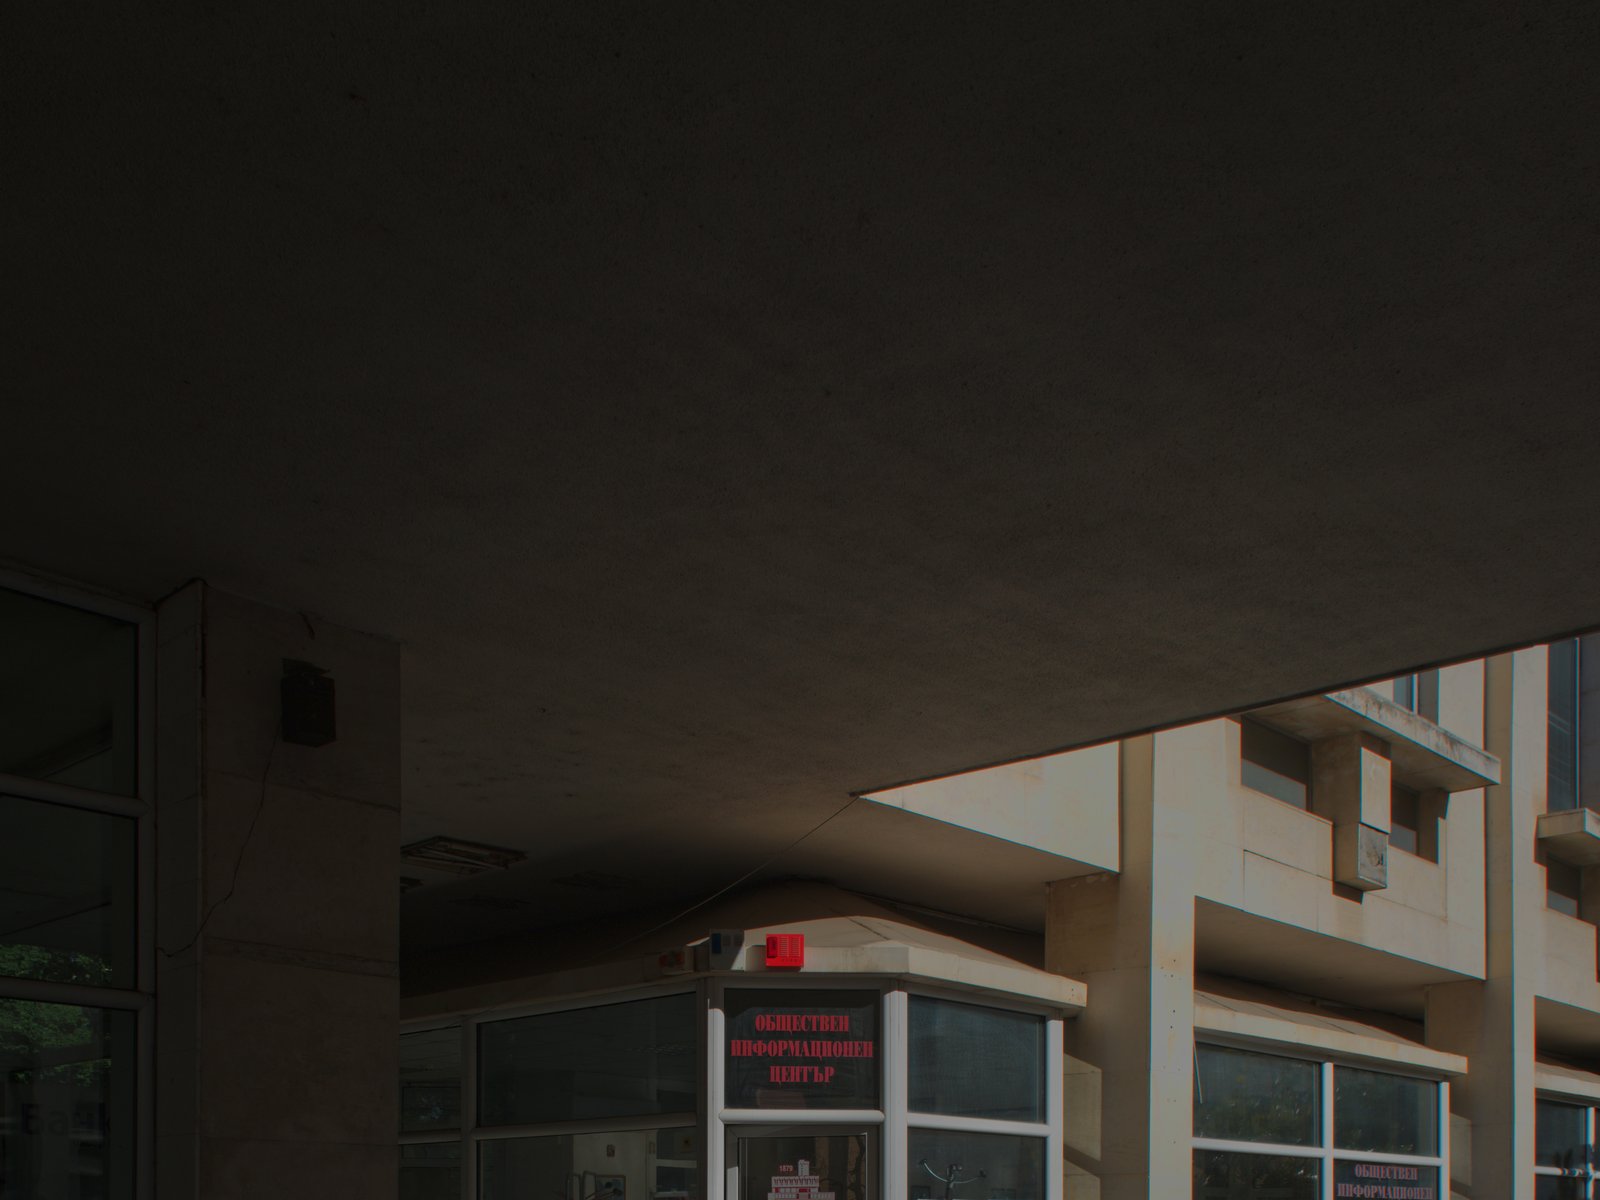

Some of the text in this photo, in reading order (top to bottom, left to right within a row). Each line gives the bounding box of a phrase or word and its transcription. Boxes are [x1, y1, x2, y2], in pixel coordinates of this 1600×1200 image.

[755, 1014, 850, 1035] ОБЩЕСТВЕН
[730, 1039, 874, 1061] ИНФОРМАЦИОНЕН
[768, 1065, 836, 1085] ЦЕНТЪР
[1354, 1164, 1418, 1181] ОБЩЕСТВЕН
[1336, 1183, 1433, 1200] ИНФОРМАЦИОНЕН
